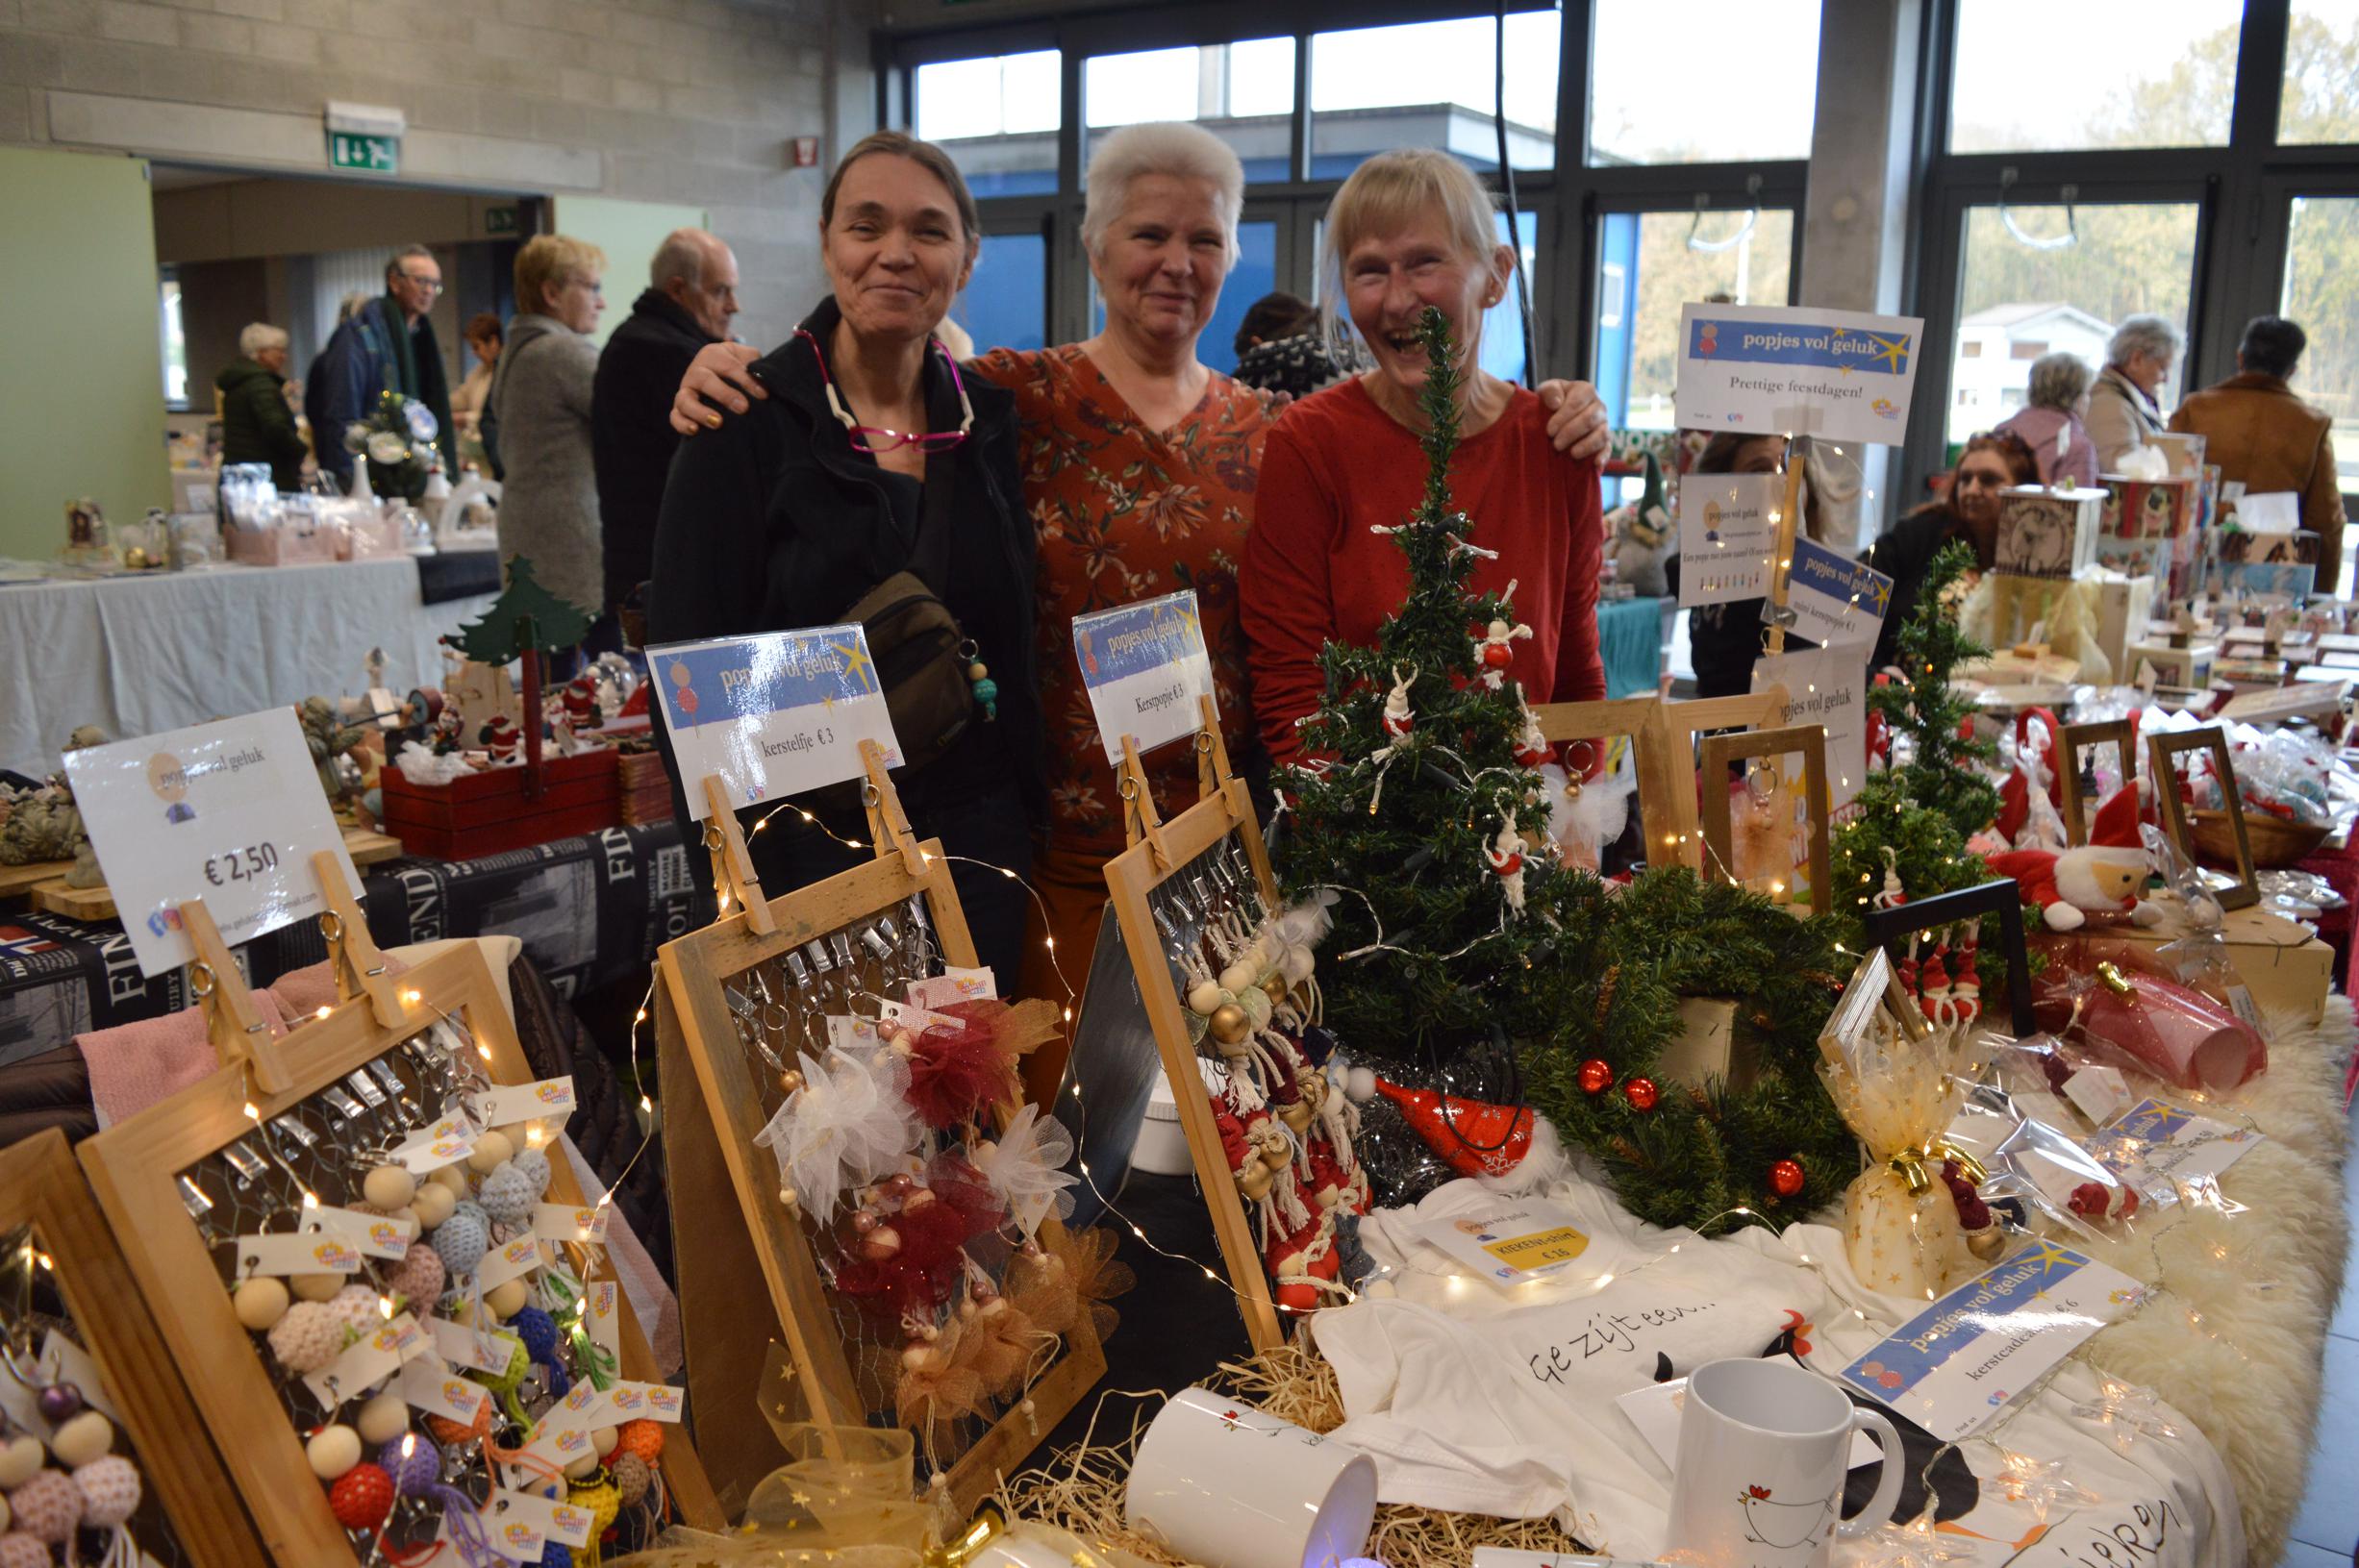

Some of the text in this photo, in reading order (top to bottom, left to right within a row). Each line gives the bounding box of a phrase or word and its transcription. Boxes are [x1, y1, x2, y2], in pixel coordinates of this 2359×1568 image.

[1743, 333, 1878, 356] popjes vol geluk
[1730, 375, 1864, 400] Prettige feestdagen!
[1804, 557, 1837, 579] popjes
[1838, 571, 1852, 585] vol
[1107, 615, 1184, 659] popjes vol geluk
[803, 651, 845, 682] geluk
[1134, 691, 1174, 714] Kerstpopje
[1178, 683, 1185, 697] 3
[1807, 692, 1823, 711] vol
[1824, 686, 1853, 713] geluk
[761, 728, 836, 759] kerstelfje € 3
[229, 745, 266, 772] geluk
[204, 840, 279, 886] € 2,50
[1554, 1247, 1571, 1259] 16
[1909, 1263, 2043, 1355] popjes vol geluk
